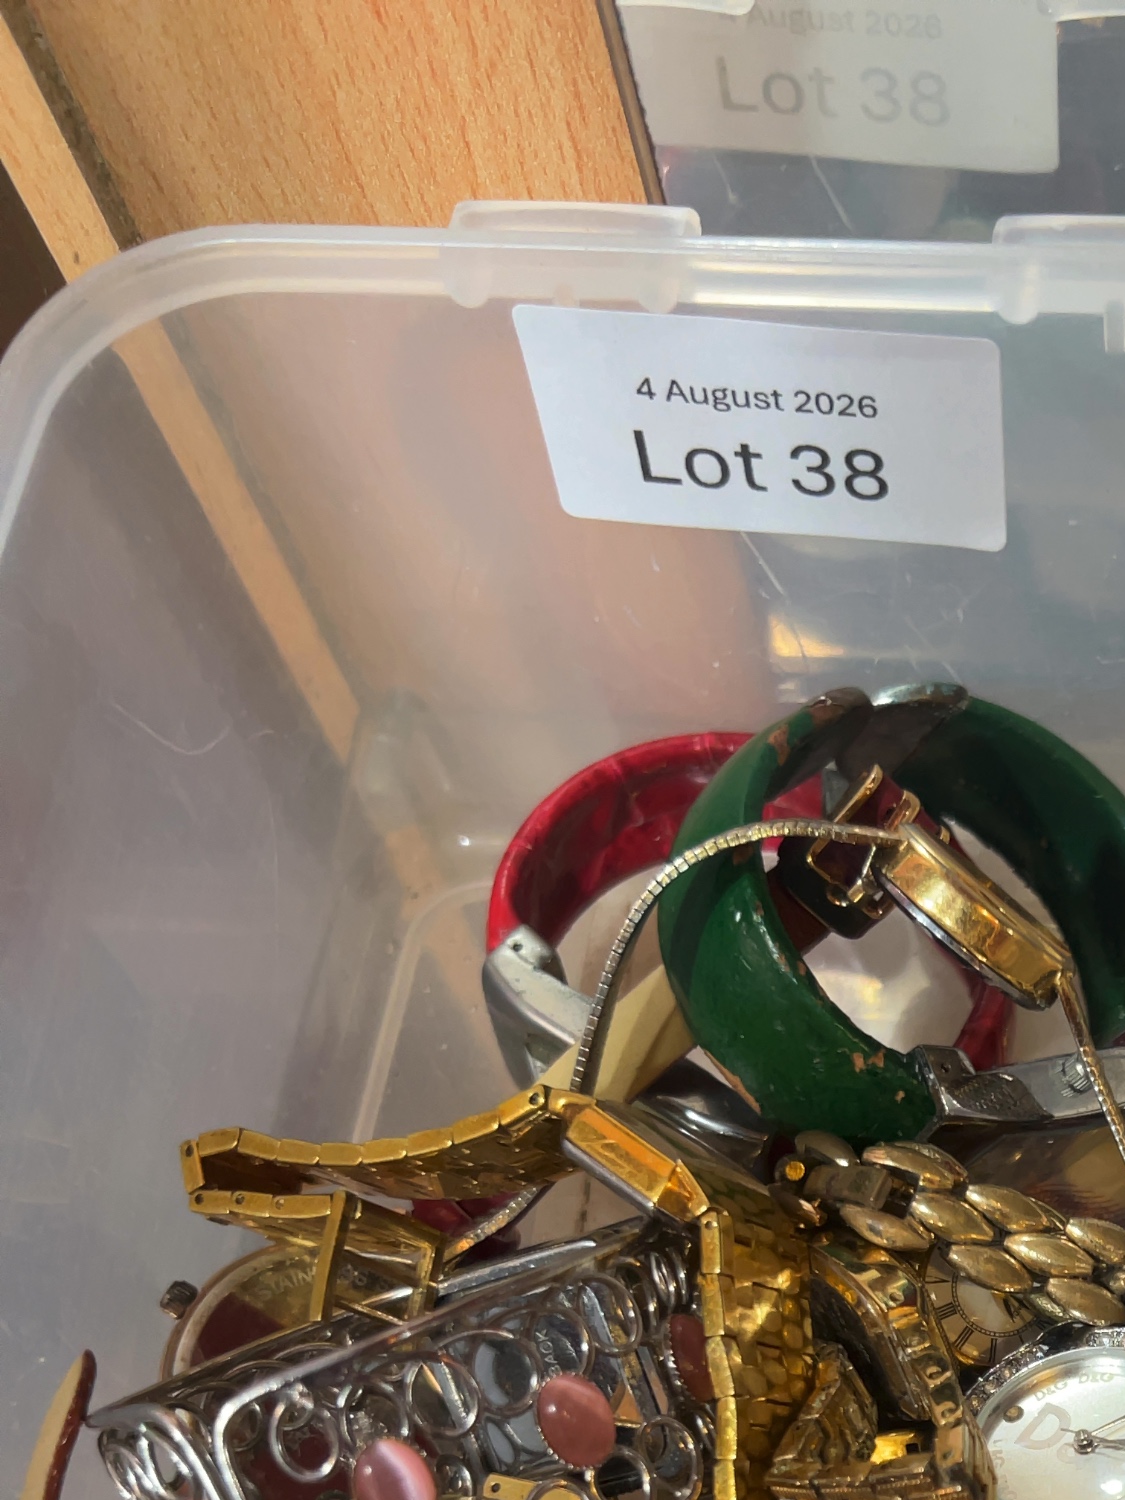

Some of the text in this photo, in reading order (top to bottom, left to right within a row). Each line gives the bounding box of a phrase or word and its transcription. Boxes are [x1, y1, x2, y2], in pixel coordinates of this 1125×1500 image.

[746, 6, 855, 36] August
[715, 56, 950, 127] Lot 38
[636, 377, 878, 418] 4 August 2026
[633, 429, 889, 501] Lot 38
[1034, 1372, 1115, 1401] D&G D&G
